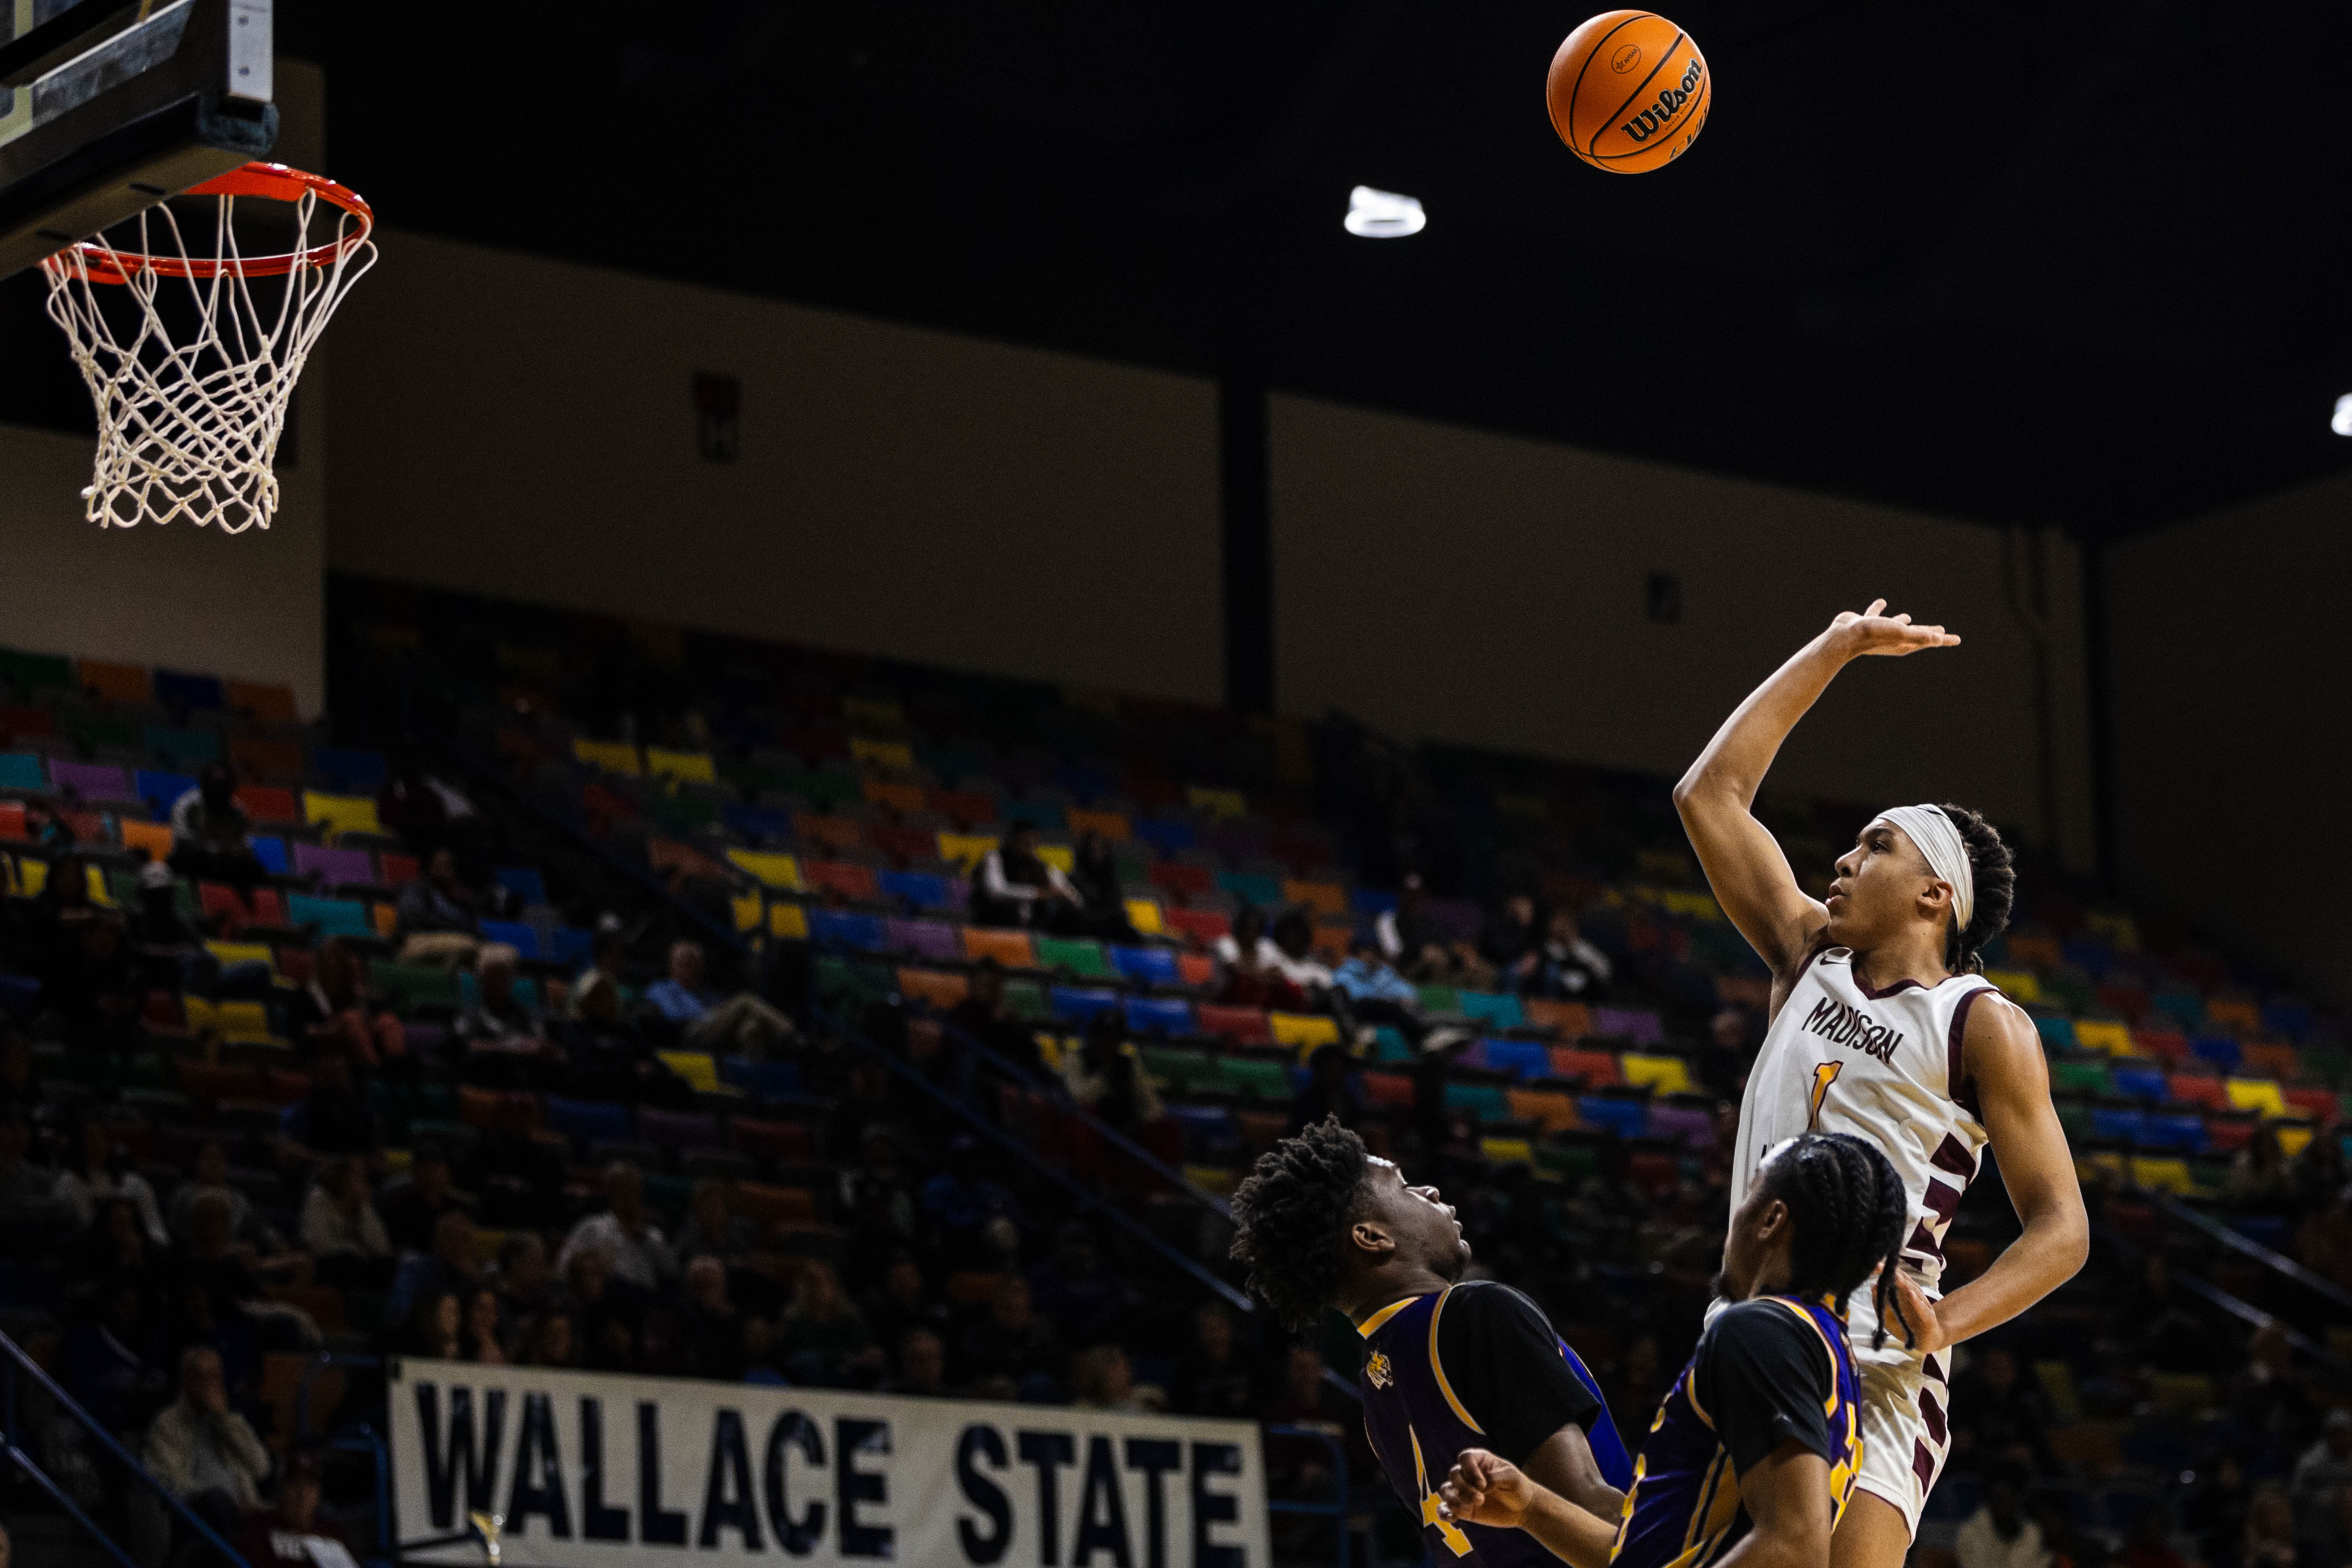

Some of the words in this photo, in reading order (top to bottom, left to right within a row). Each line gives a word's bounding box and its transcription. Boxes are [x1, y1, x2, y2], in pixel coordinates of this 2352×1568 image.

[1621, 59, 1703, 142] Wilson
[1802, 997, 1903, 1064] MADISON
[1808, 1060, 1843, 1132] 1
[414, 1382, 894, 1559] WALLACE
[955, 1423, 1249, 1568] STATE
